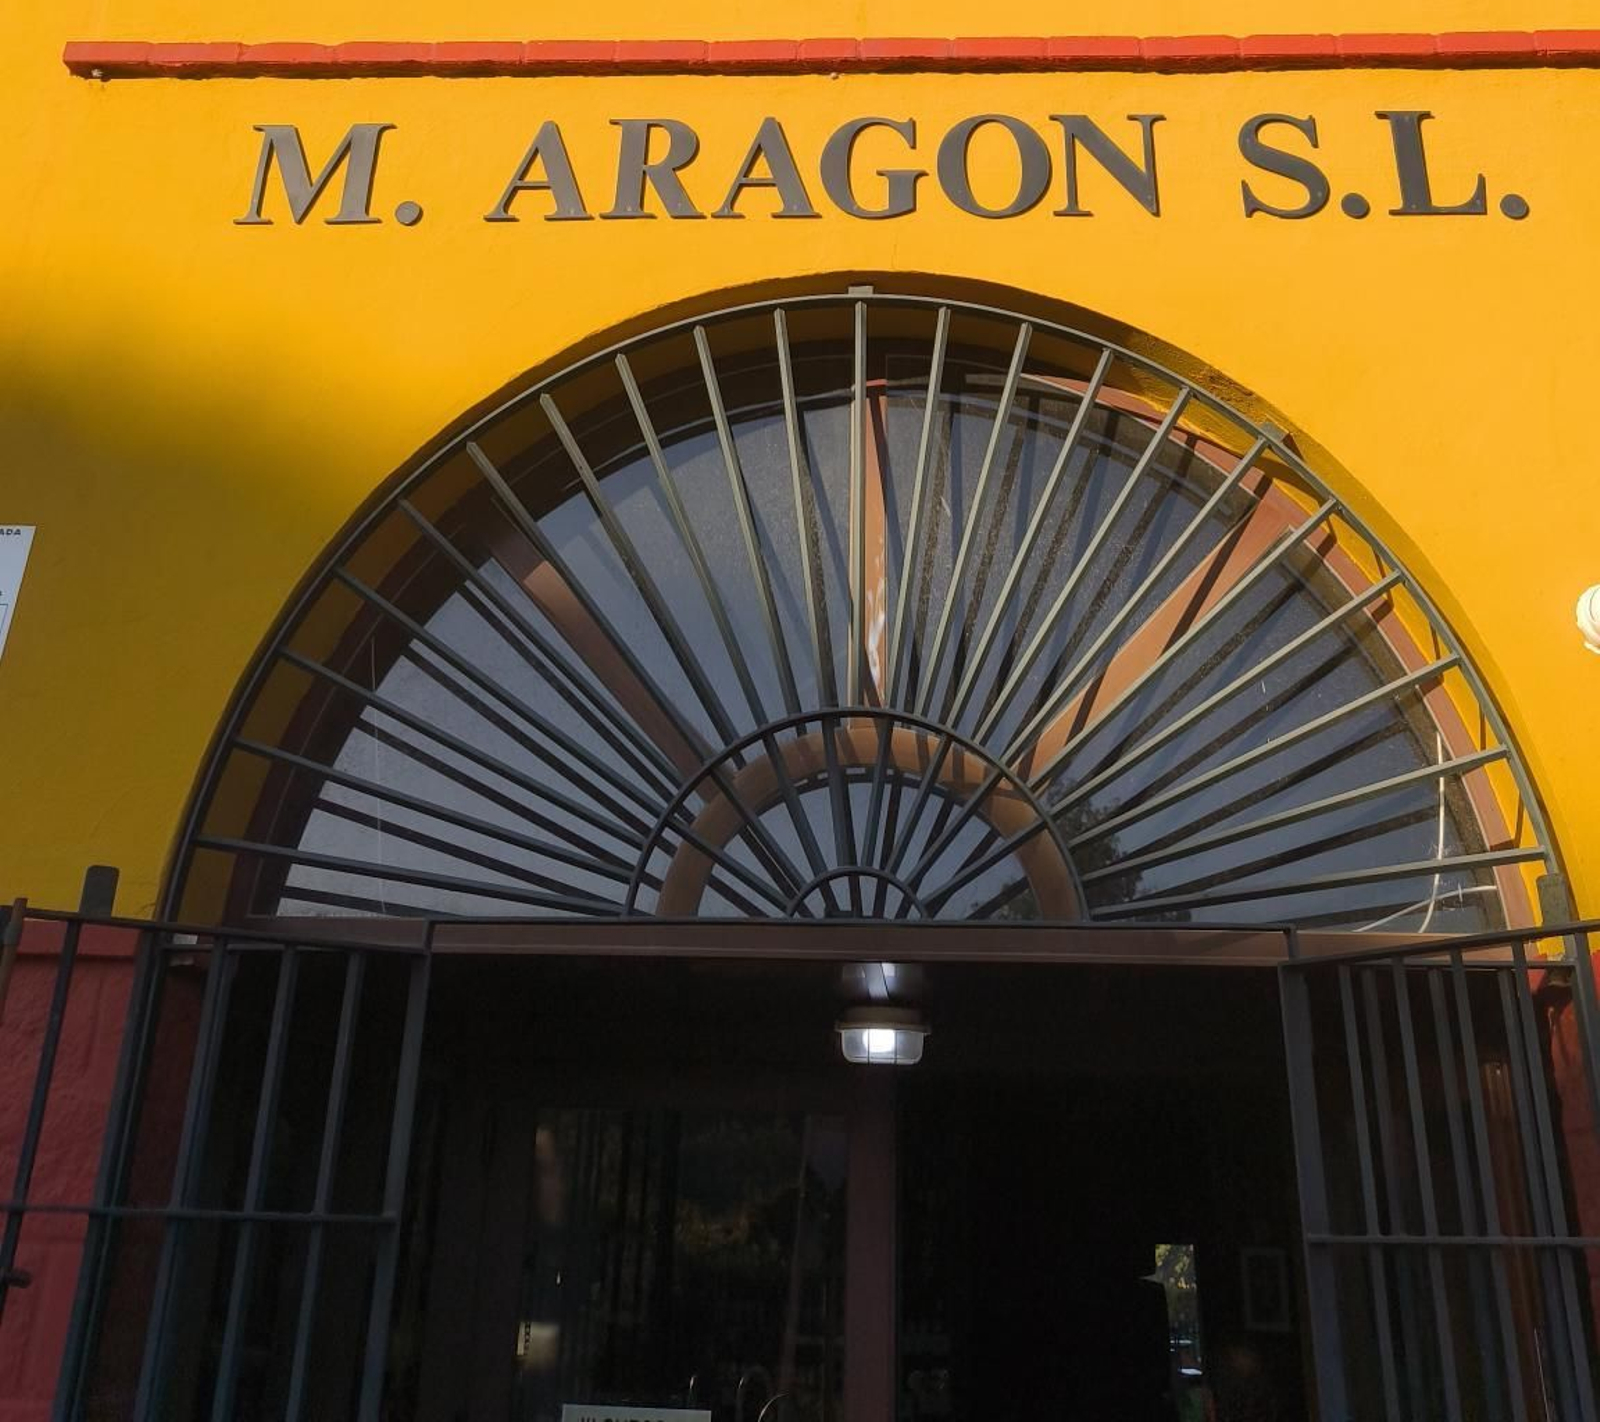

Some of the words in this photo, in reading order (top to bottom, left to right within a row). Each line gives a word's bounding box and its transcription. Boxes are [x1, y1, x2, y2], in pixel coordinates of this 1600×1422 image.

[233, 122, 424, 227] M.
[483, 113, 1166, 223] ARAGON
[1238, 110, 1530, 221] S.L.
